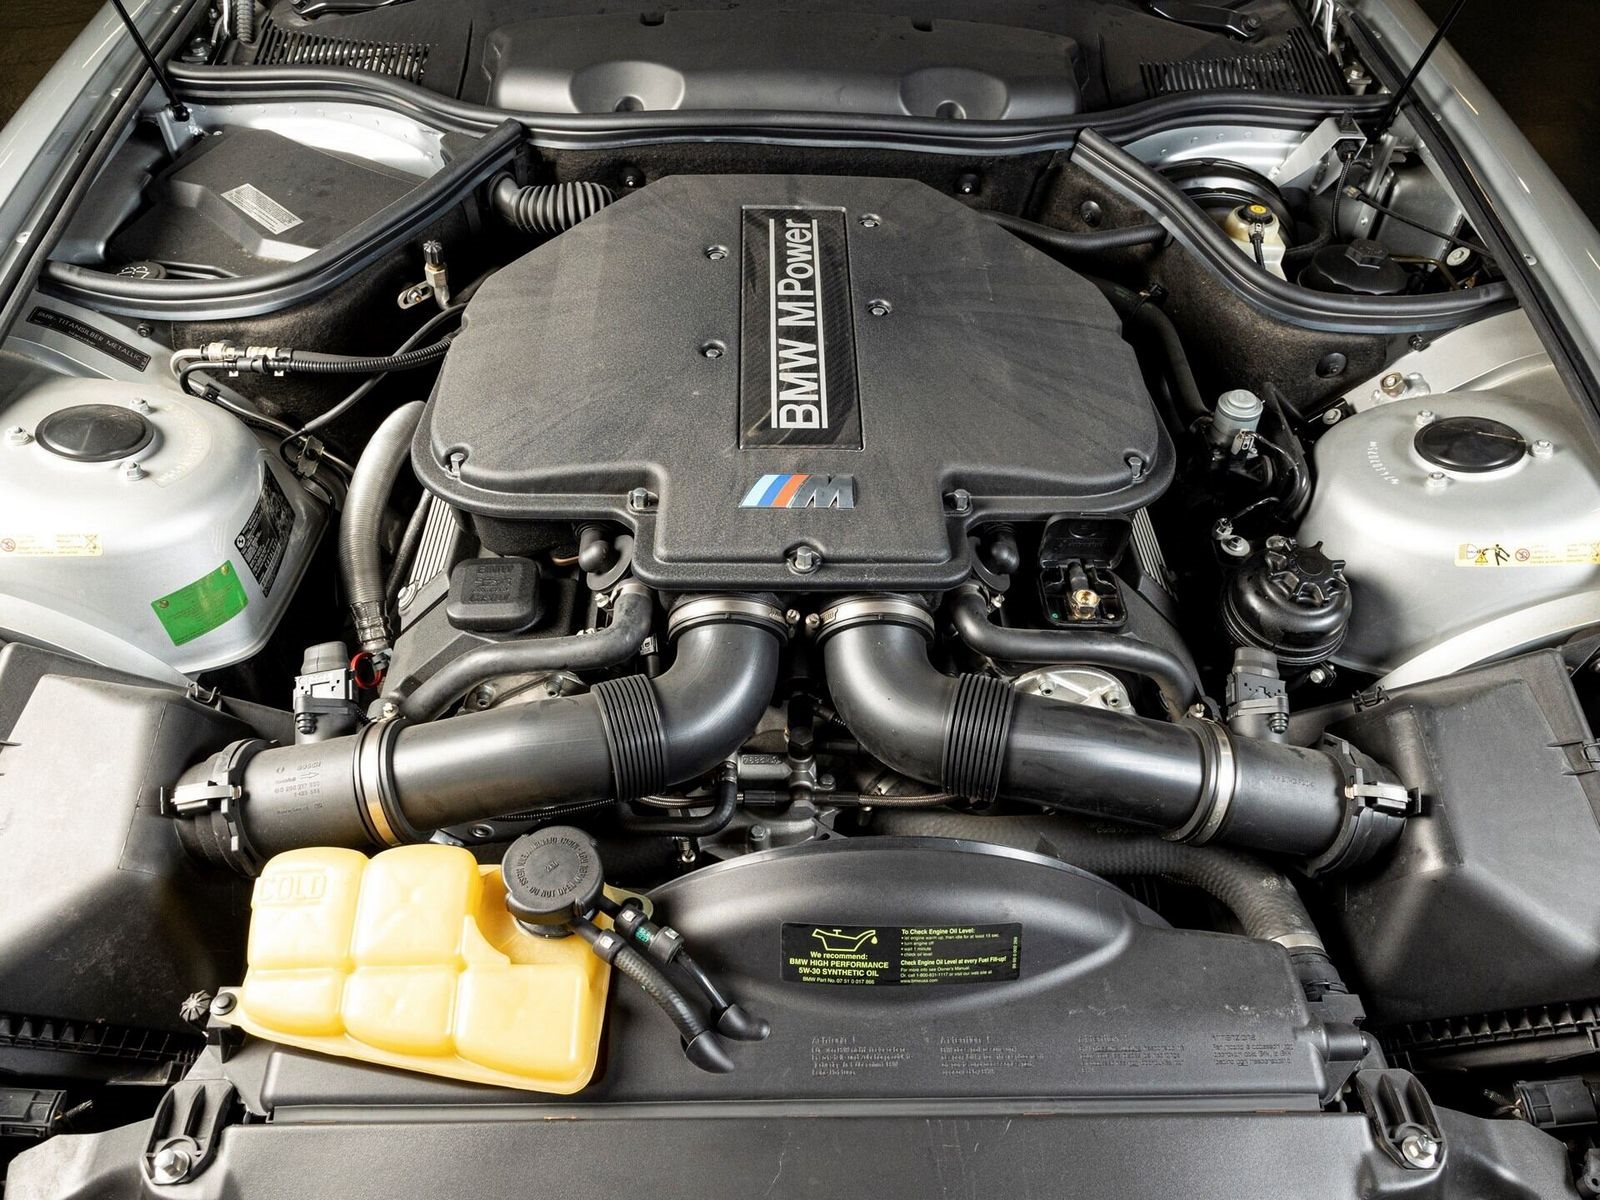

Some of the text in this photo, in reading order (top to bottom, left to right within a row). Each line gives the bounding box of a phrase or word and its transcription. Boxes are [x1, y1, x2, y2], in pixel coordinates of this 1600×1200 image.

[778, 338, 820, 429] BMW
[789, 473, 857, 509] M
[259, 874, 328, 902] COLD
[929, 928, 948, 936] Engine
[810, 951, 822, 959] We
[789, 957, 889, 969] BMW HIGH PERFORMANCE
[917, 959, 935, 967] Engine
[798, 967, 880, 977] 5W-30 SYNTHETIC OIL
